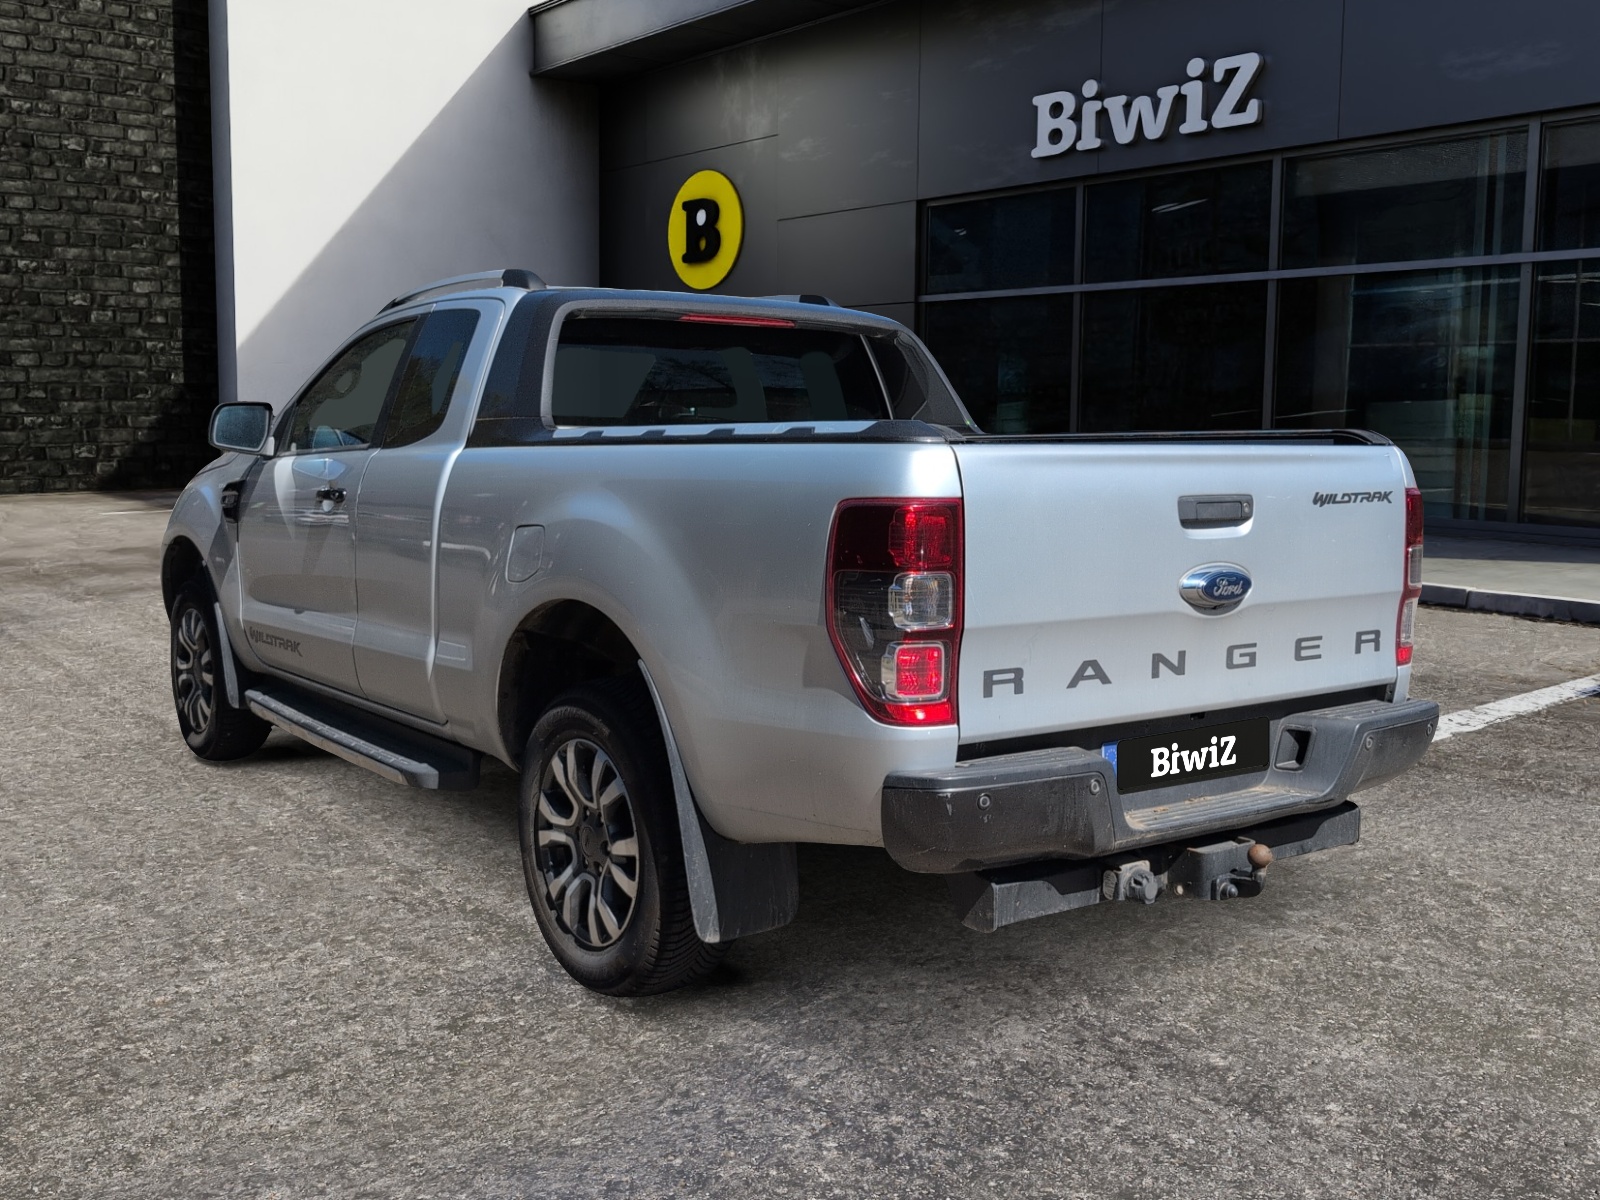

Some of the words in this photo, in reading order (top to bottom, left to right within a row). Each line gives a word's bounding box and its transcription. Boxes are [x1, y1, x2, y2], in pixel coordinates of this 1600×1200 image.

[1031, 52, 1264, 158] BiwiZ
[682, 198, 721, 264] B
[1312, 491, 1393, 507] WILDTRAK
[1213, 577, 1243, 596] Ford
[249, 626, 303, 657] WILDTRAK
[983, 629, 1381, 698] RANGER
[1150, 735, 1237, 778] BiwiZ
